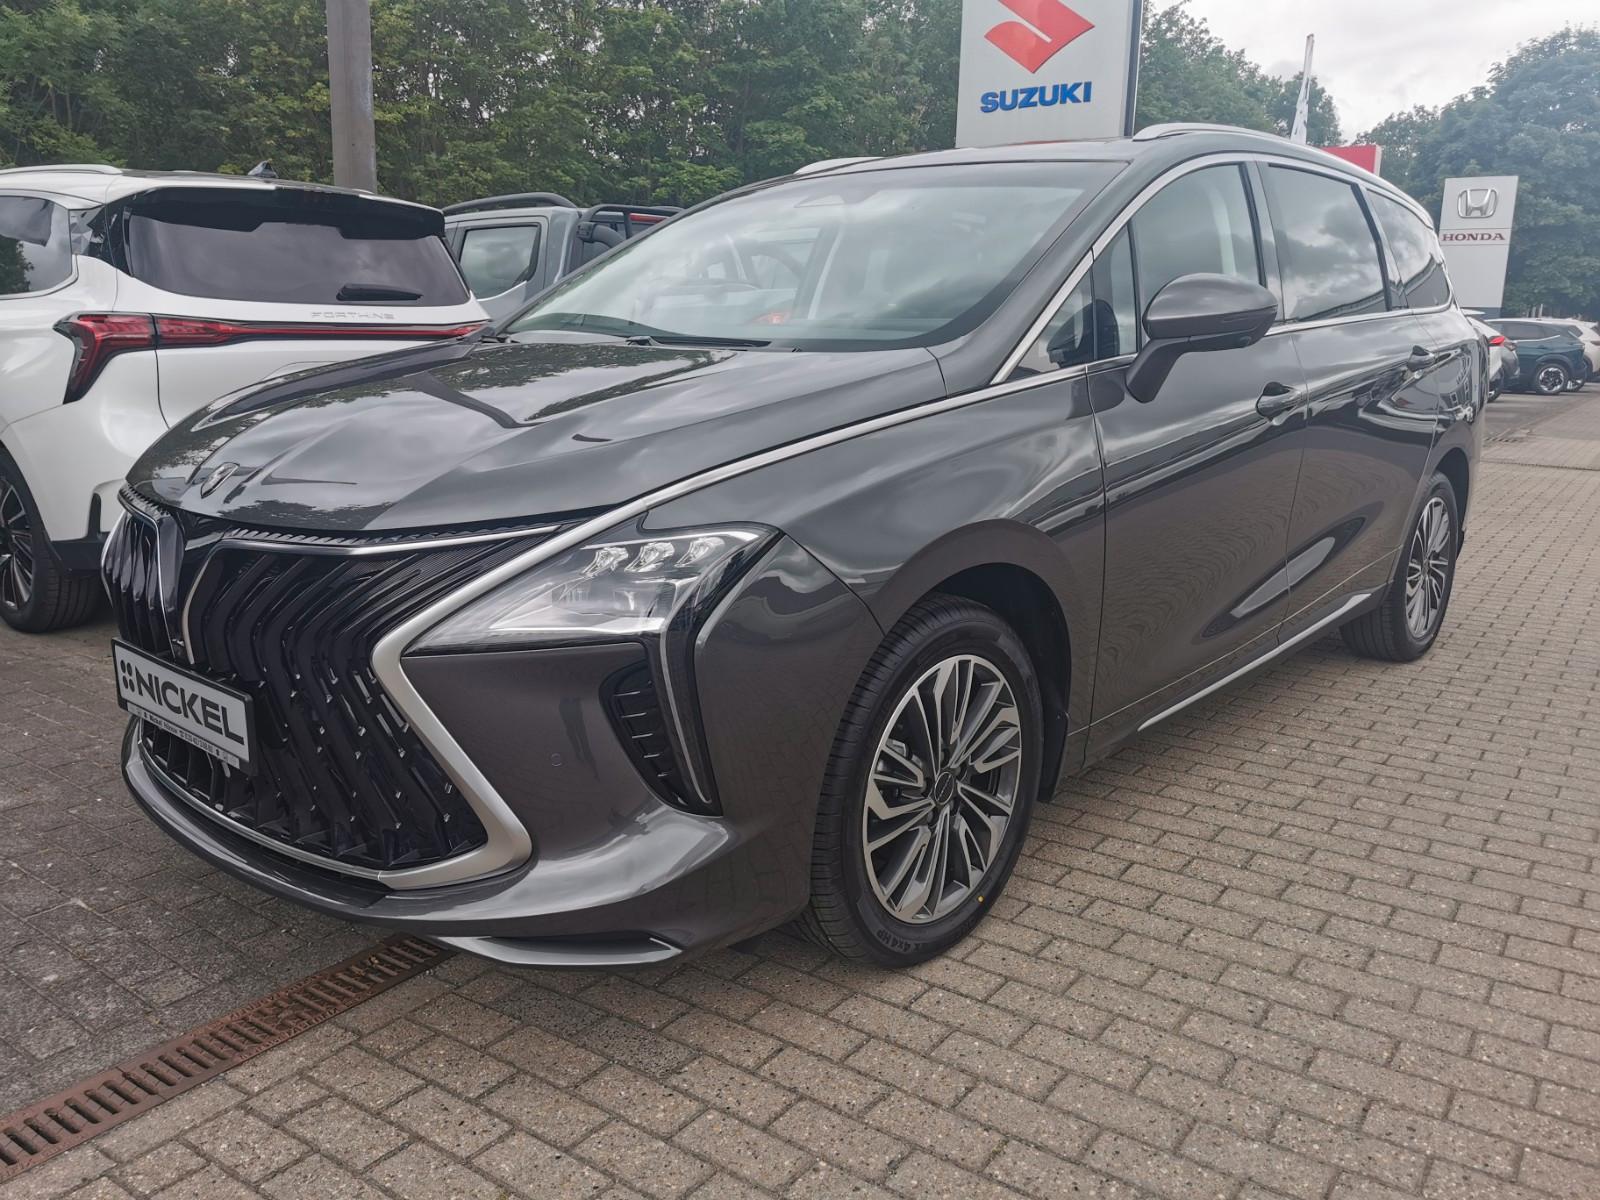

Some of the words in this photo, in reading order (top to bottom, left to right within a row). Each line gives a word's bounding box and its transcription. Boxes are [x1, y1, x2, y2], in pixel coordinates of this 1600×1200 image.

[980, 81, 1092, 113] SUZUKI
[1442, 232, 1505, 242] HONDA
[134, 665, 245, 746] NICKEL
